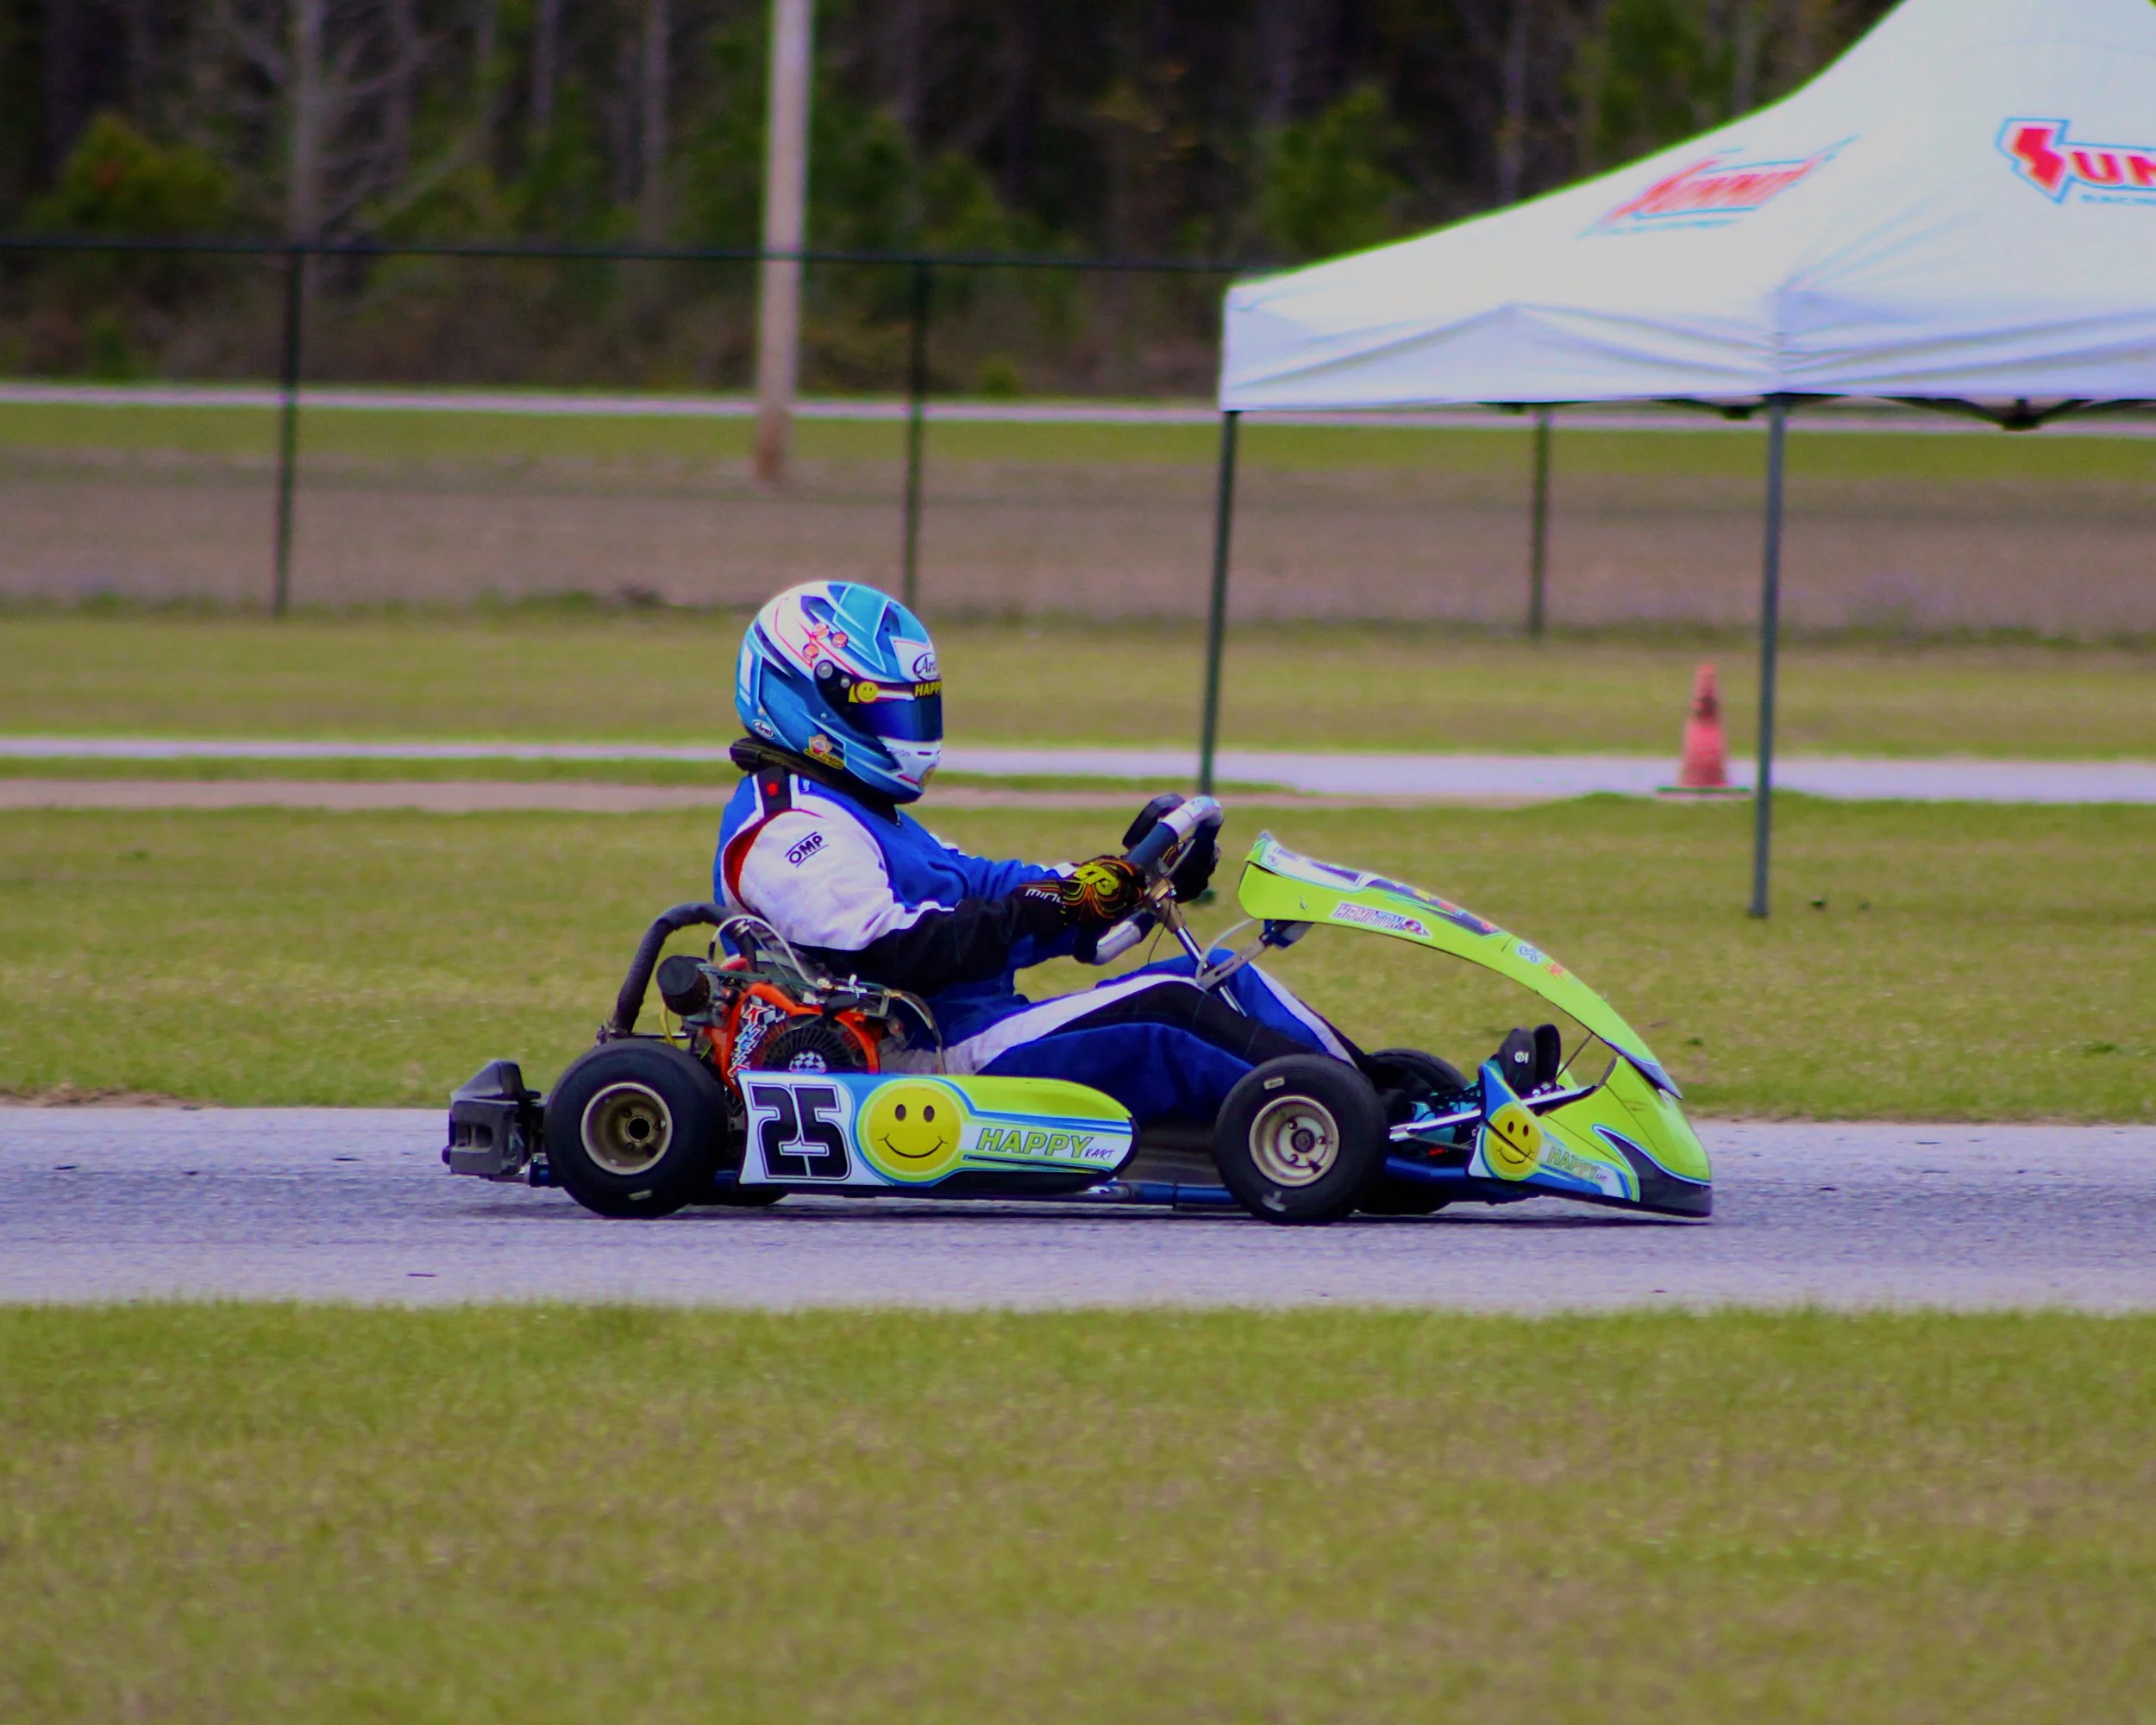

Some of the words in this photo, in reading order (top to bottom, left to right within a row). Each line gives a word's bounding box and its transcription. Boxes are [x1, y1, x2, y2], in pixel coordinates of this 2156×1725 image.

[789, 835, 823, 864] OMP
[748, 1082, 851, 1182] 25
[976, 1127, 1094, 1158] HAPPY
[1084, 1148, 1115, 1161] KART
